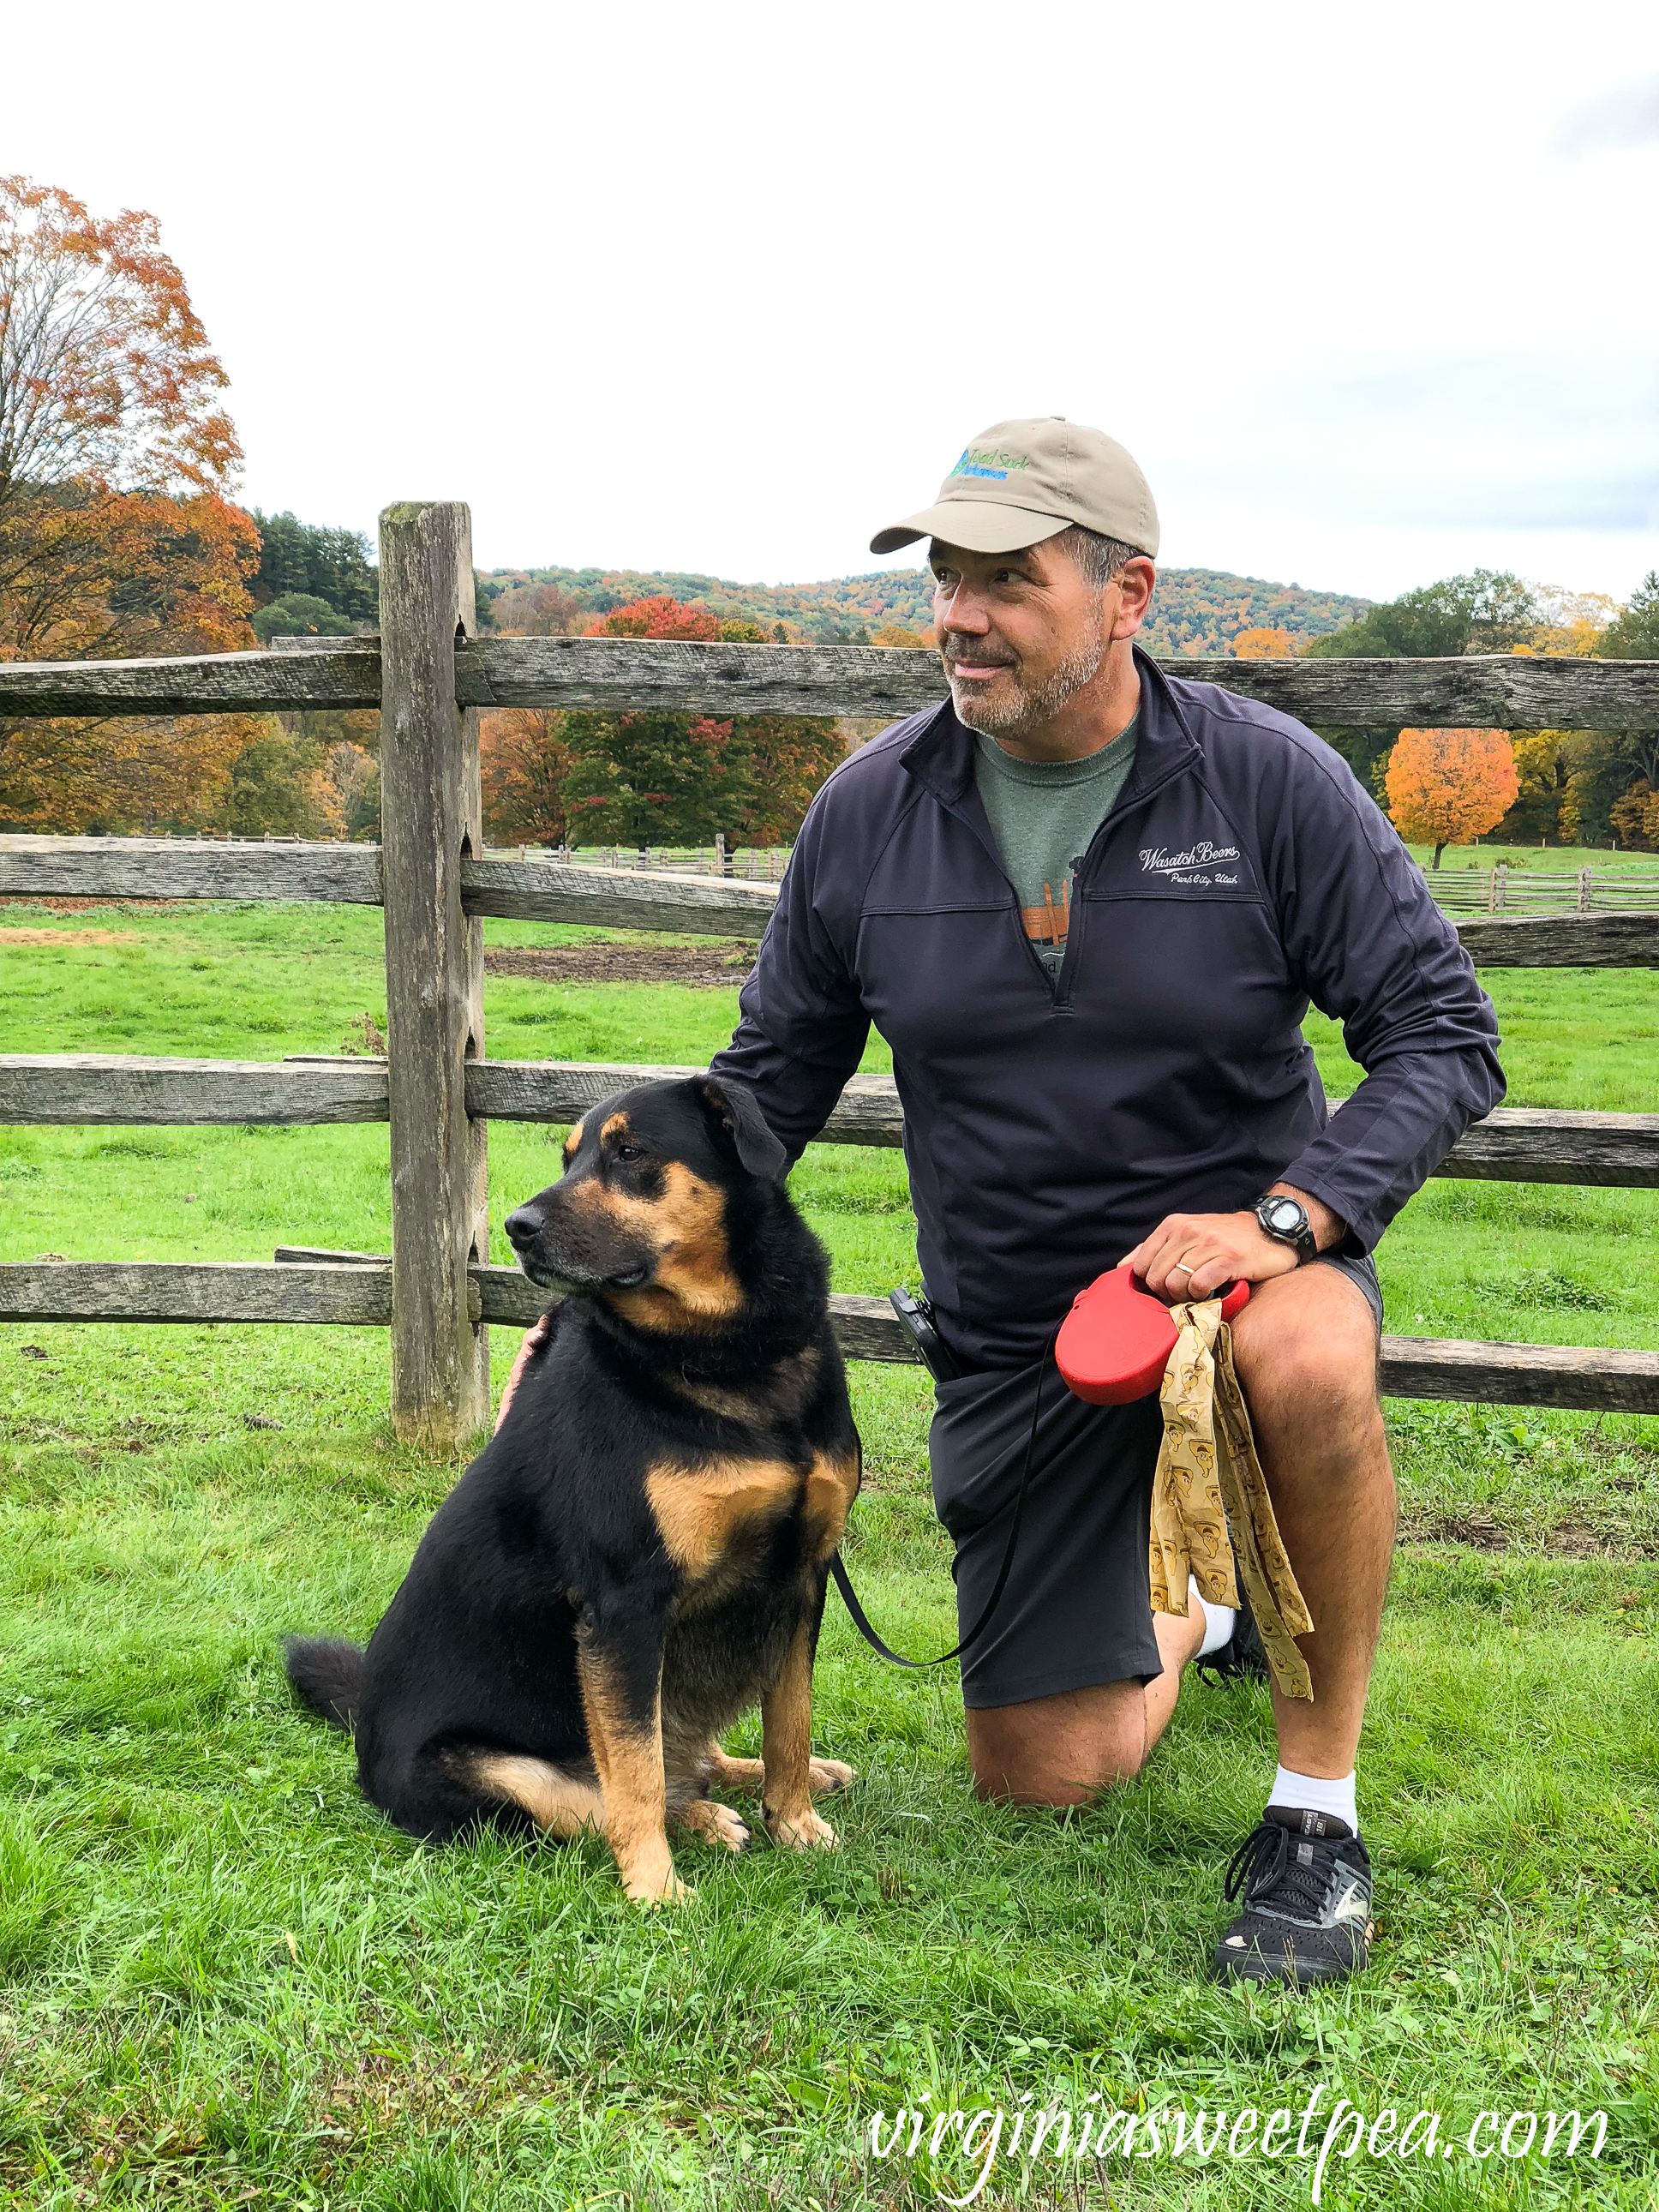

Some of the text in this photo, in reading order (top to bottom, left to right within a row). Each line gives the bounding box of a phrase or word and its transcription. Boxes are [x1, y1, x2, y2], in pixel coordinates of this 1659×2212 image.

[1139, 841, 1239, 872] Wasatch Beers
[1171, 872, 1193, 884] Park
[1214, 872, 1238, 884] Utah
